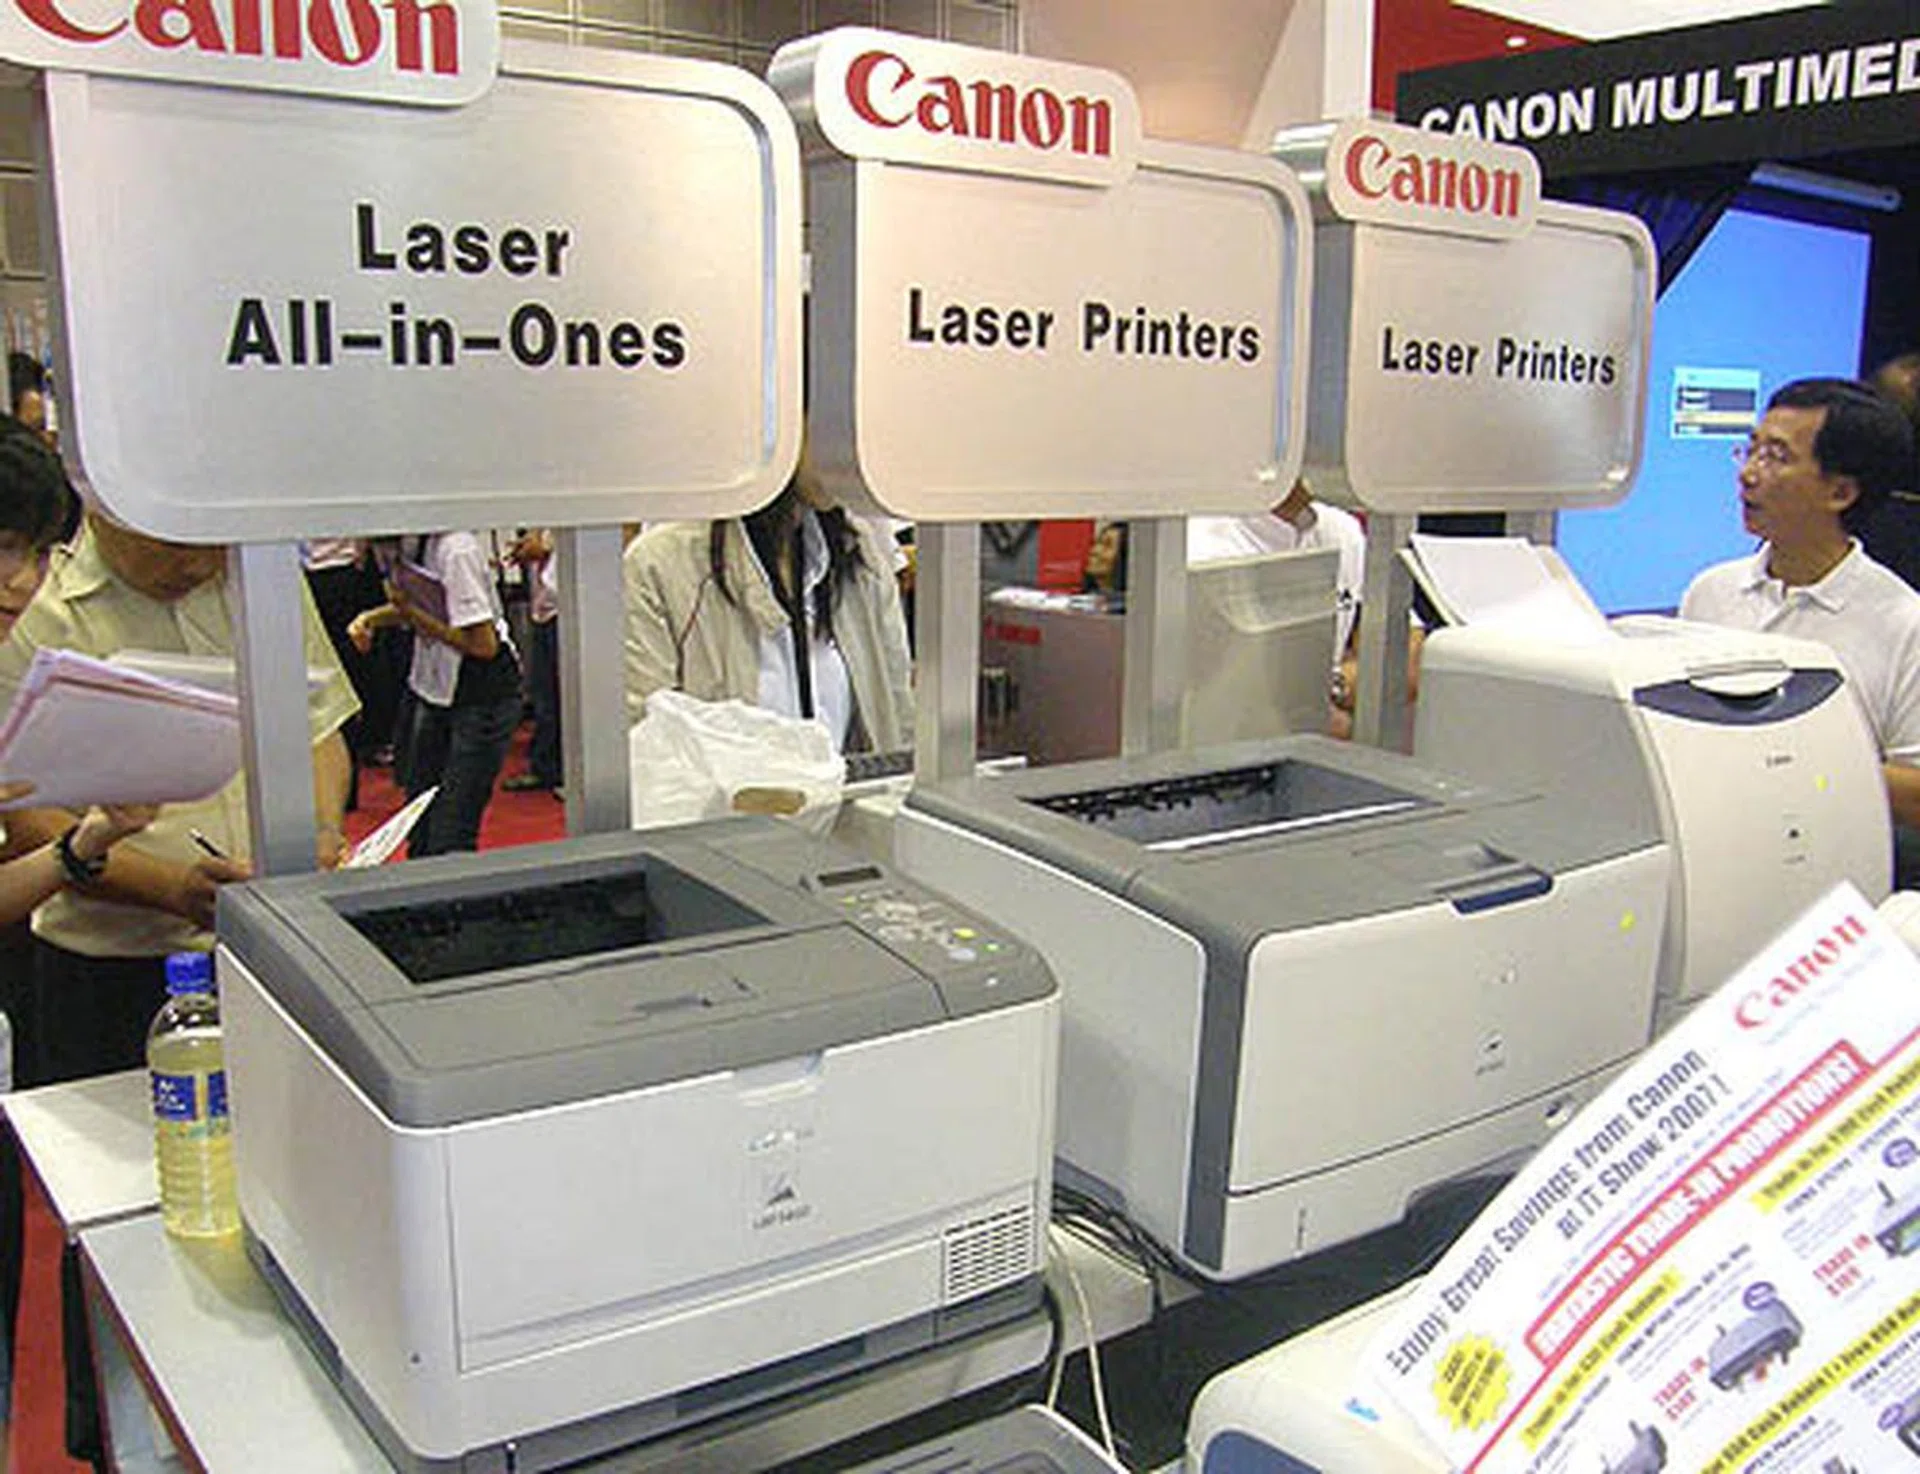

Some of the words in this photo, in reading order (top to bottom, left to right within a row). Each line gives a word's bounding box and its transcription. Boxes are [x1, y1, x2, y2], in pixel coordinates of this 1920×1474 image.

[845, 50, 1113, 156] Canon
[1345, 136, 1521, 218] Canon
[356, 204, 570, 276] Laser
[227, 298, 686, 368] All-in-Ones
[908, 288, 1054, 350] Laser
[1083, 302, 1260, 363] Printers
[1382, 328, 1479, 376] Laser
[1496, 338, 1616, 386] Printers
[1735, 915, 1867, 1030] Canon
[1598, 1136, 1664, 1196] Show
[1385, 1304, 1450, 1376] Enjoy
[1440, 1246, 1505, 1313] Great
[1493, 1162, 1582, 1252] Savings
[1574, 1112, 1636, 1170] from
[1627, 1049, 1708, 1120] Canon
